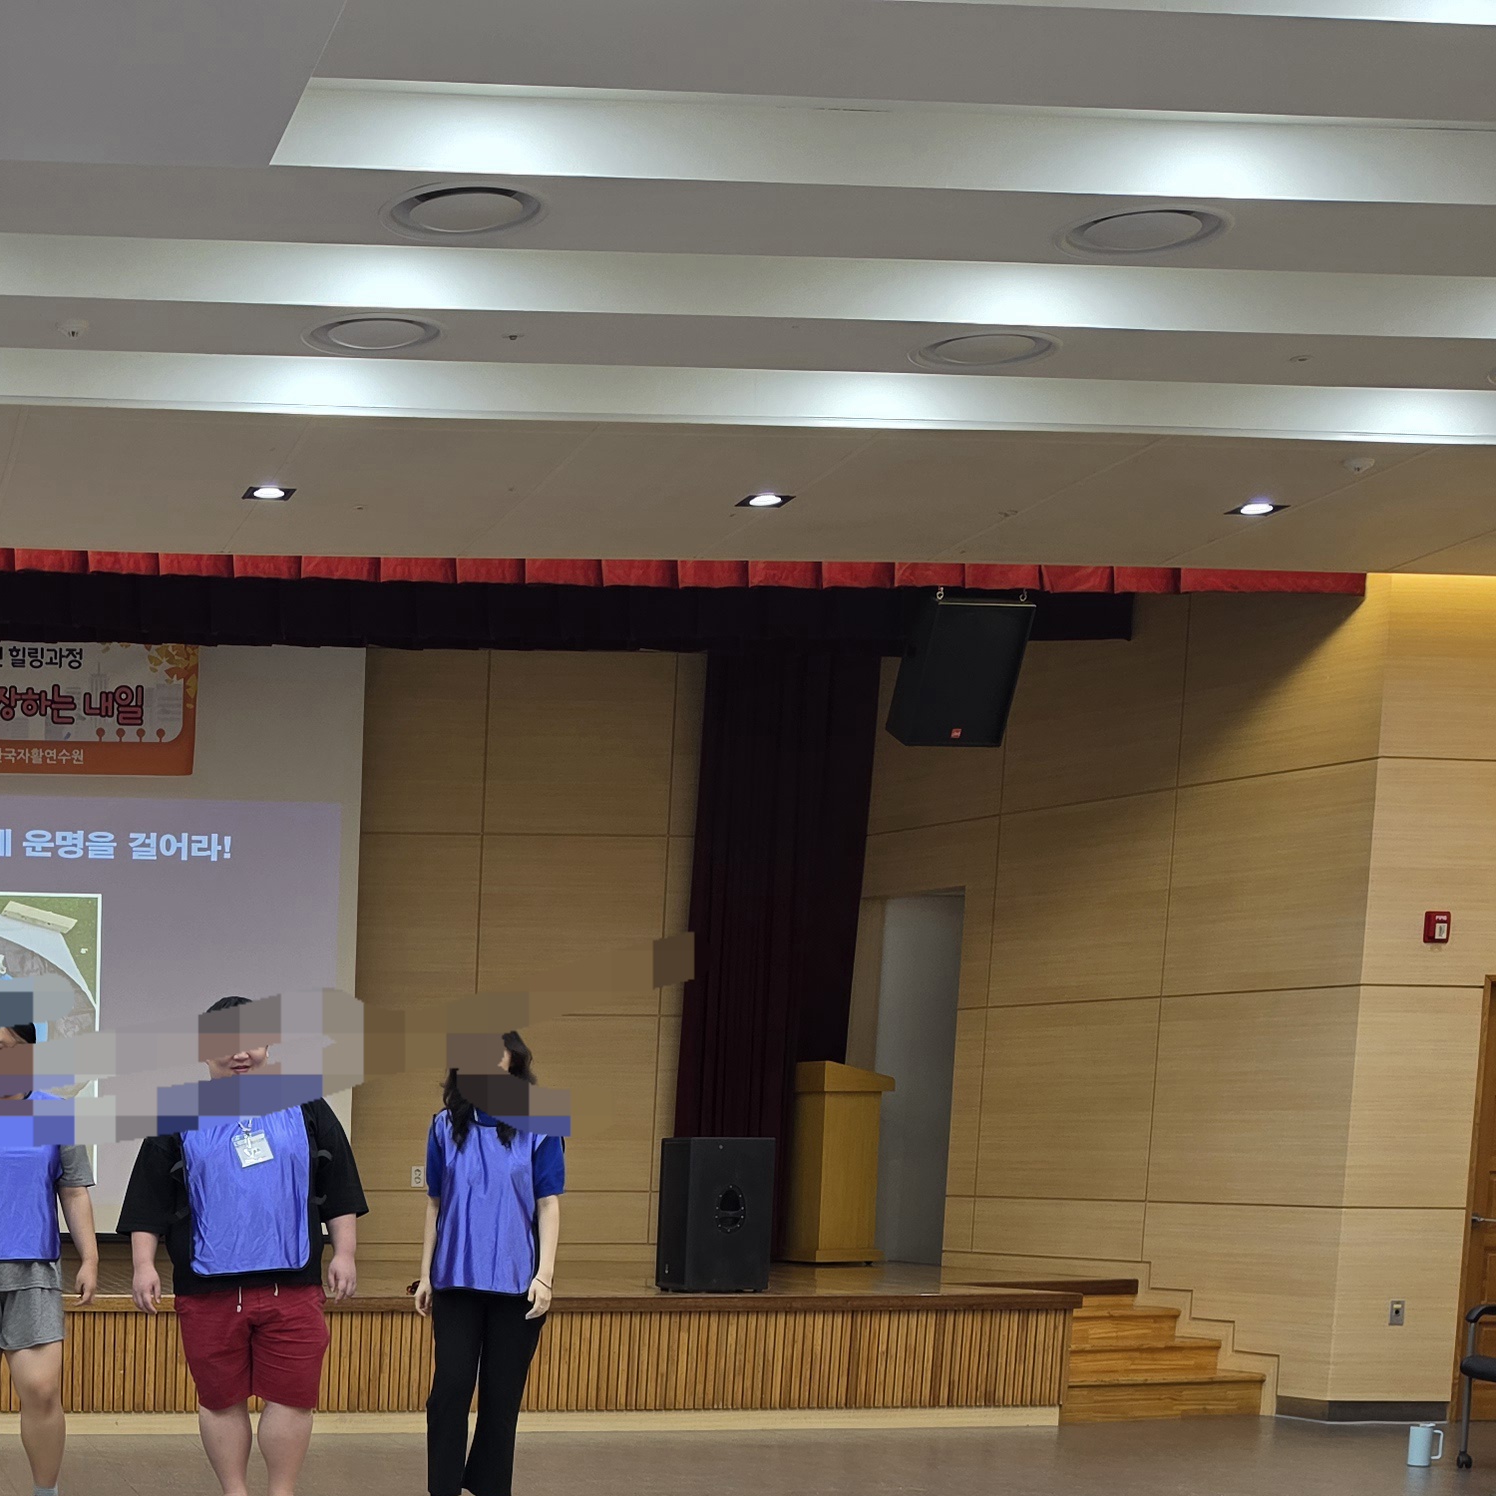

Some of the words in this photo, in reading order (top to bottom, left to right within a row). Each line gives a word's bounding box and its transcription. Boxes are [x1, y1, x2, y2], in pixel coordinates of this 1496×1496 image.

[8, 645, 84, 669] 힐링과정
[84, 684, 144, 726] 내일
[23, 829, 117, 859] 운명을
[128, 832, 231, 861] 걸어라!
